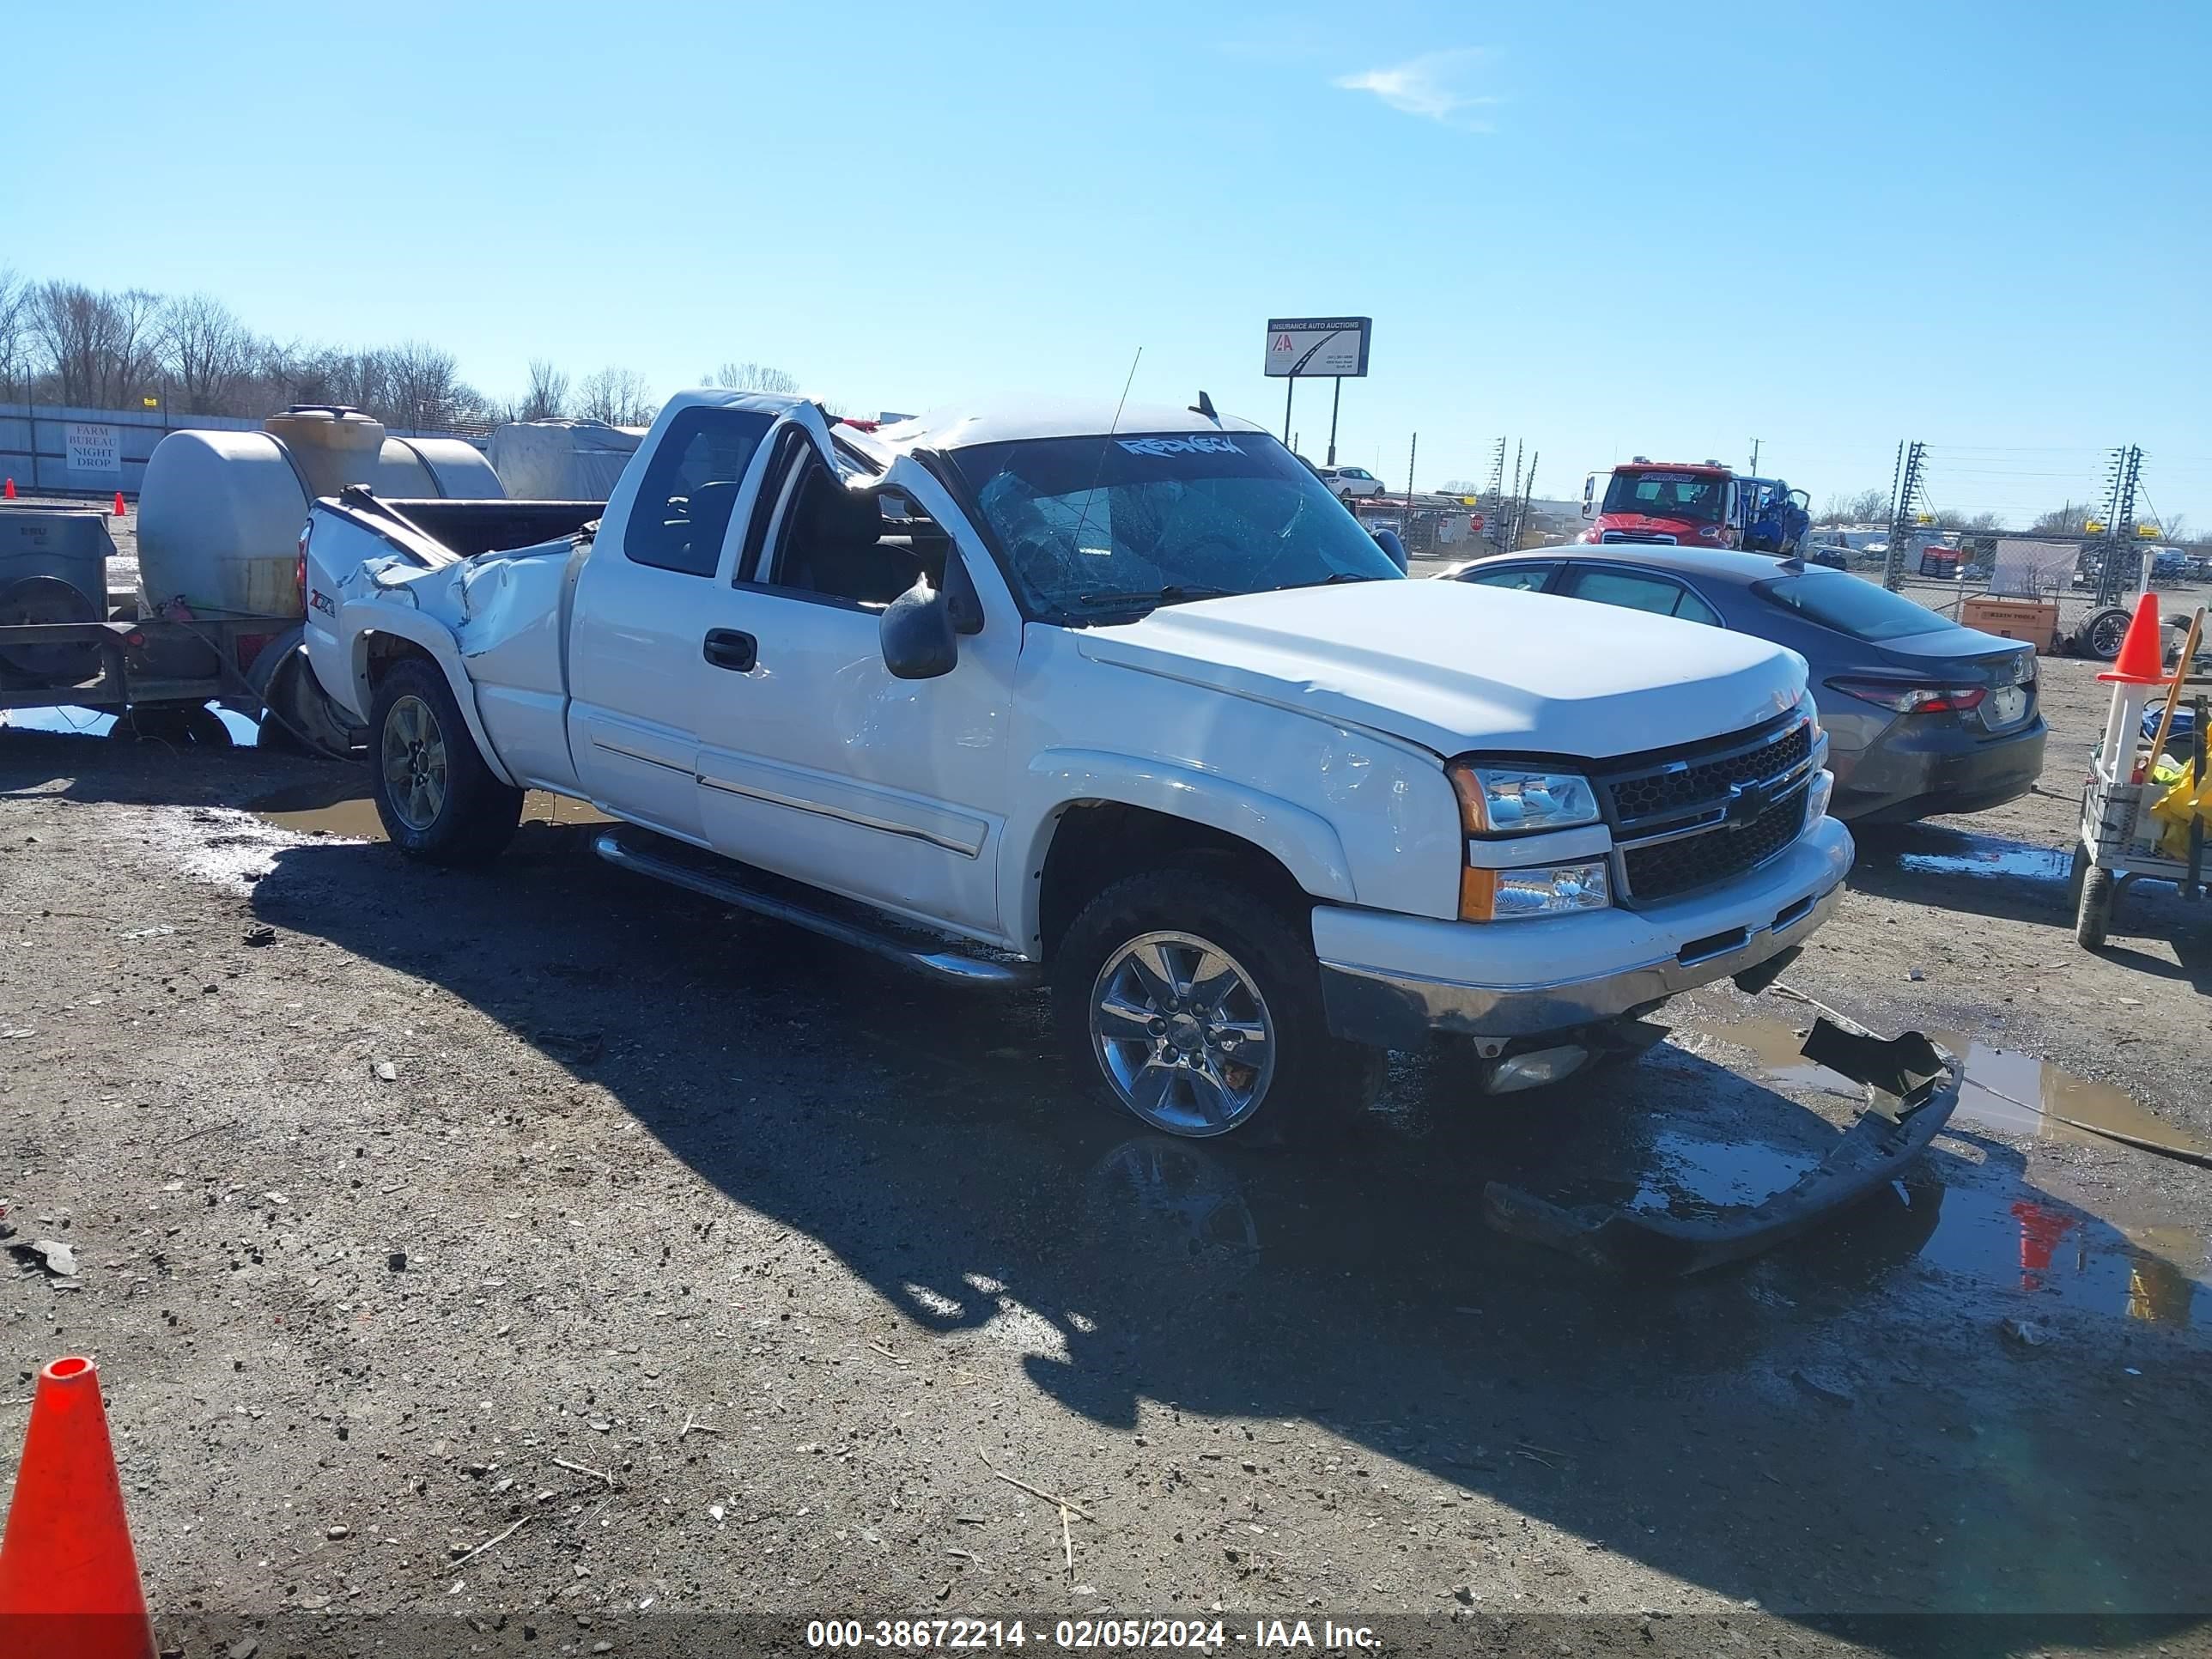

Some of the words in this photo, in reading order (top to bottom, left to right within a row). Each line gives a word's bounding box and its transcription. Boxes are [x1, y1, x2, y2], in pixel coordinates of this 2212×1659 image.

[1272, 322, 1307, 331] INSURANCE
[76, 425, 109, 435] FARM
[70, 435, 117, 447] BUREAU
[74, 447, 114, 458] NIGHT
[77, 458, 112, 468] DROP
[309, 588, 336, 618] Z71
